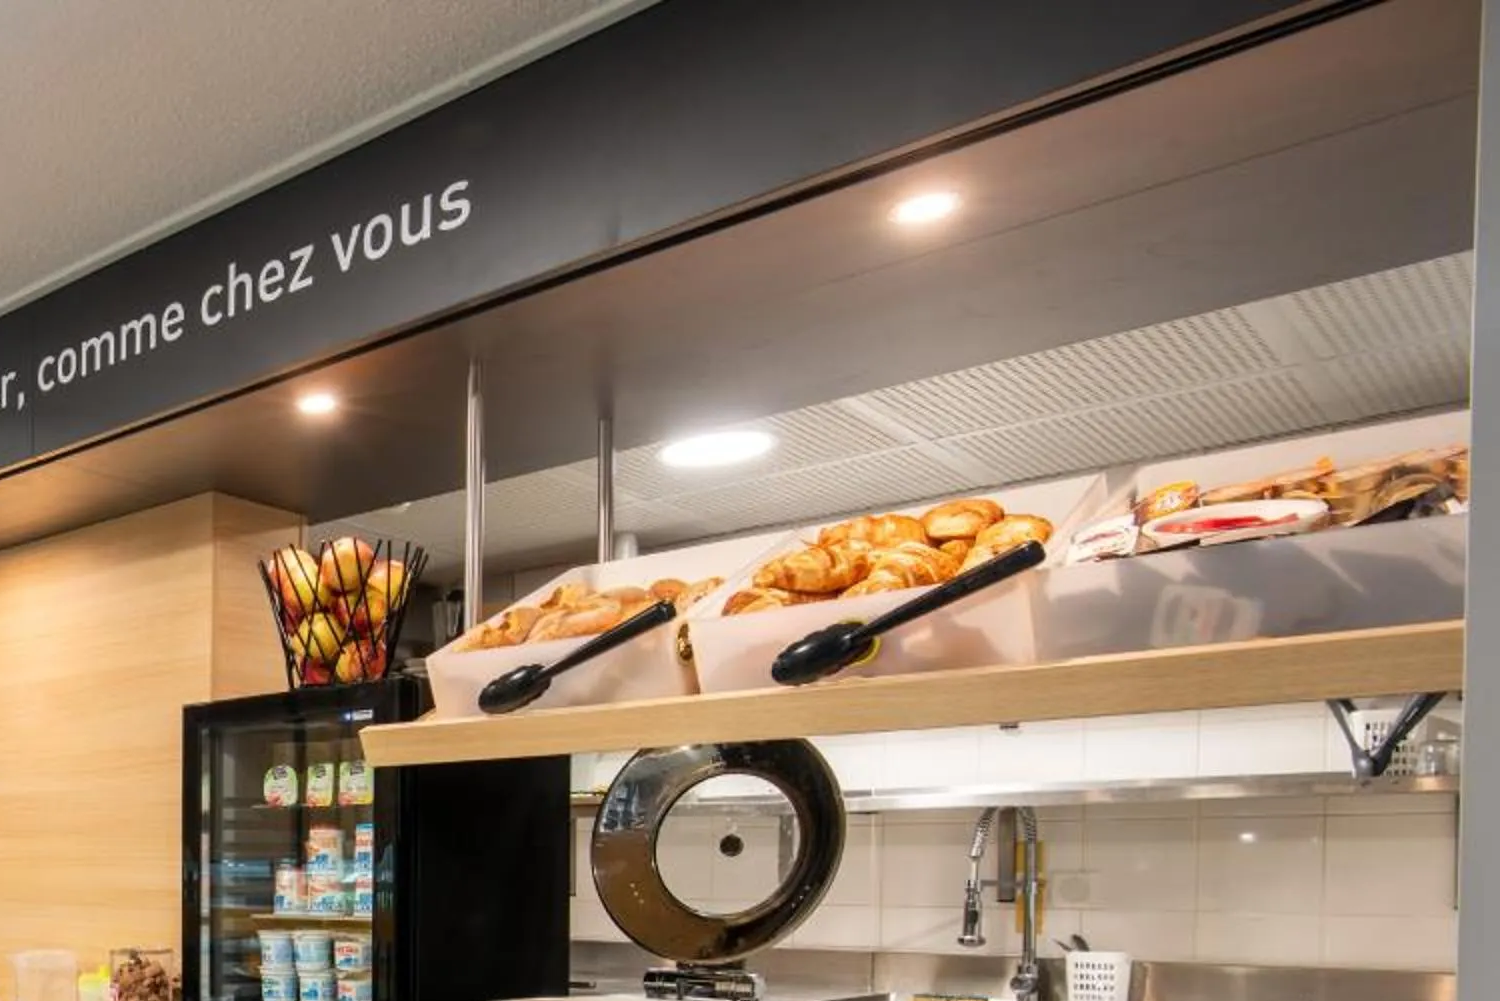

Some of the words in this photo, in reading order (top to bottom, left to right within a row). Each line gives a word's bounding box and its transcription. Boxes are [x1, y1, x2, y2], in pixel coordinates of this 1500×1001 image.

[37, 301, 185, 392] comme
[200, 244, 315, 326] chez
[330, 180, 472, 273] vous
